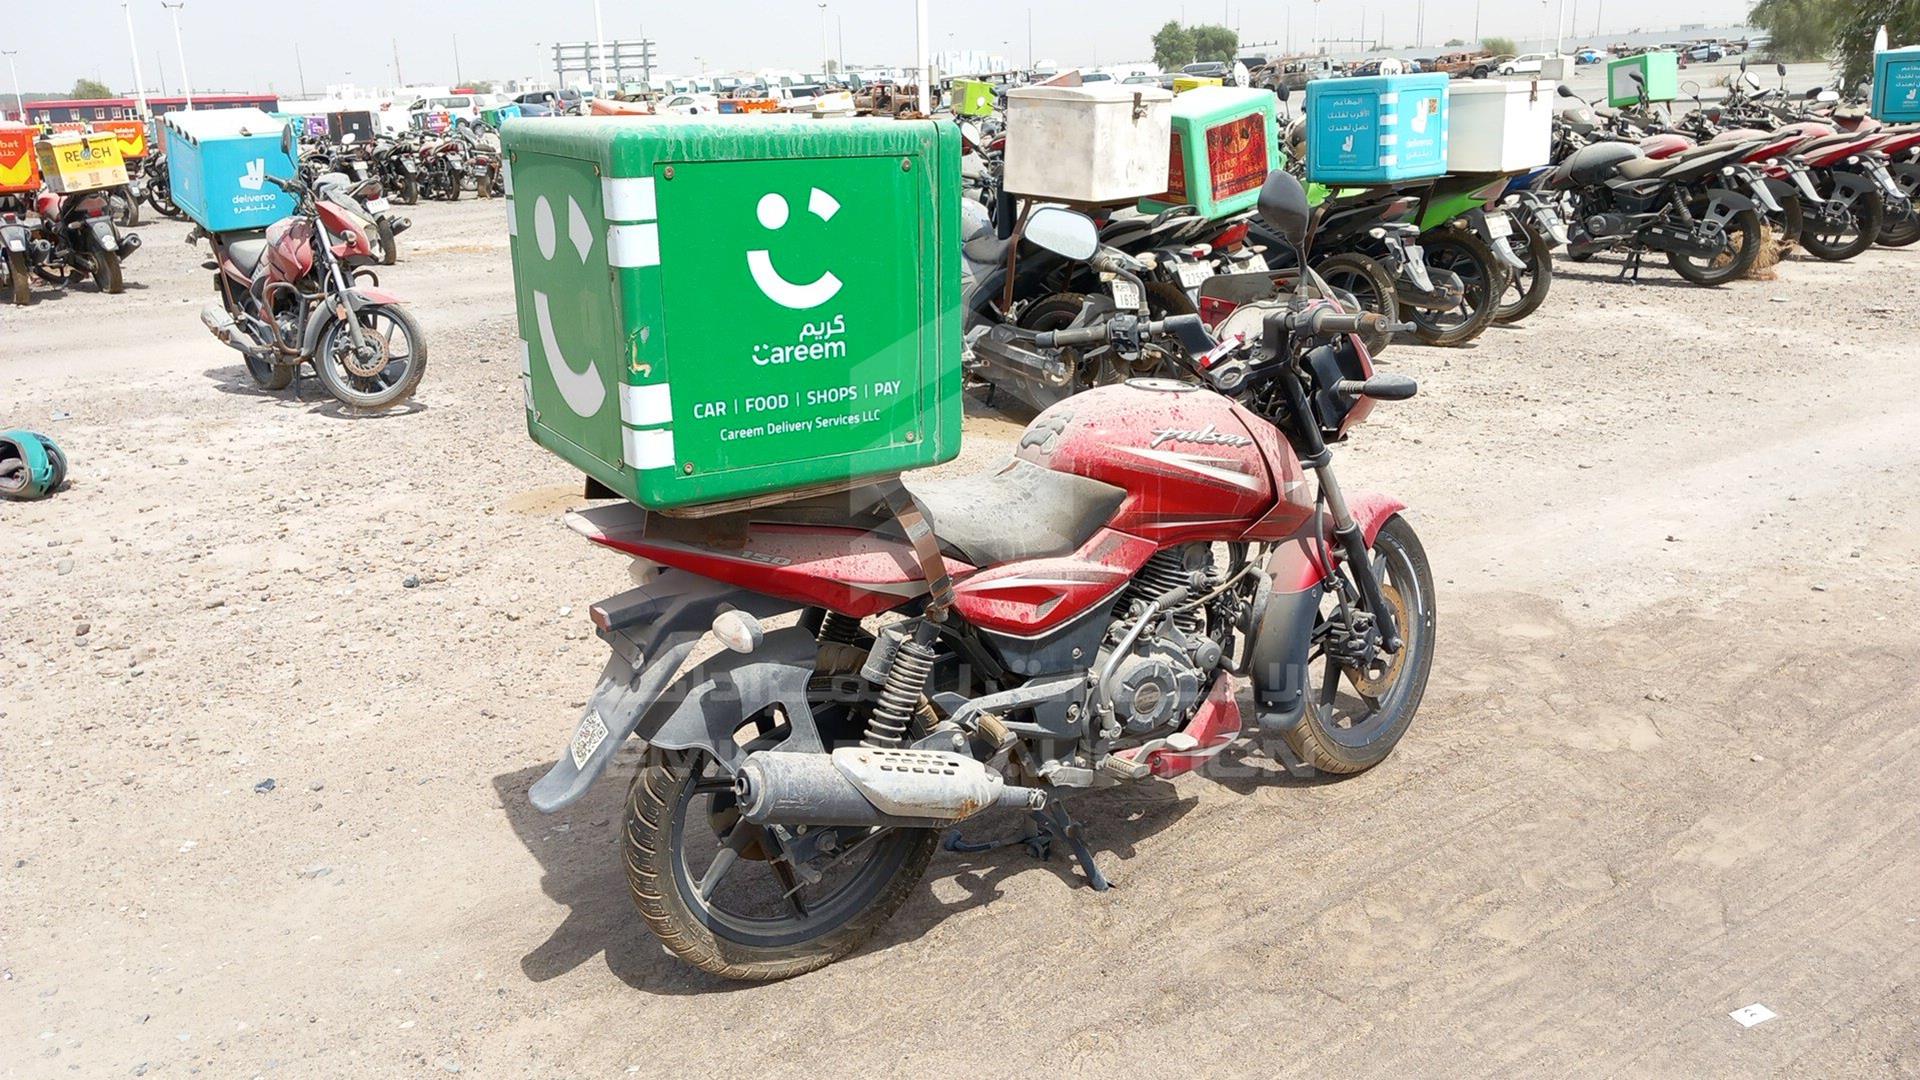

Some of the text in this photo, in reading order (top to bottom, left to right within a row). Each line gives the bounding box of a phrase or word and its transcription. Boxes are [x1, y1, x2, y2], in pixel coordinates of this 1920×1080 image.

[232, 193, 276, 204] deliveroo
[800, 314, 845, 341] كريم
[693, 380, 901, 420] CAR FOOD SHOPS PAY
[720, 409, 881, 441] Careem Delivery Services LLC
